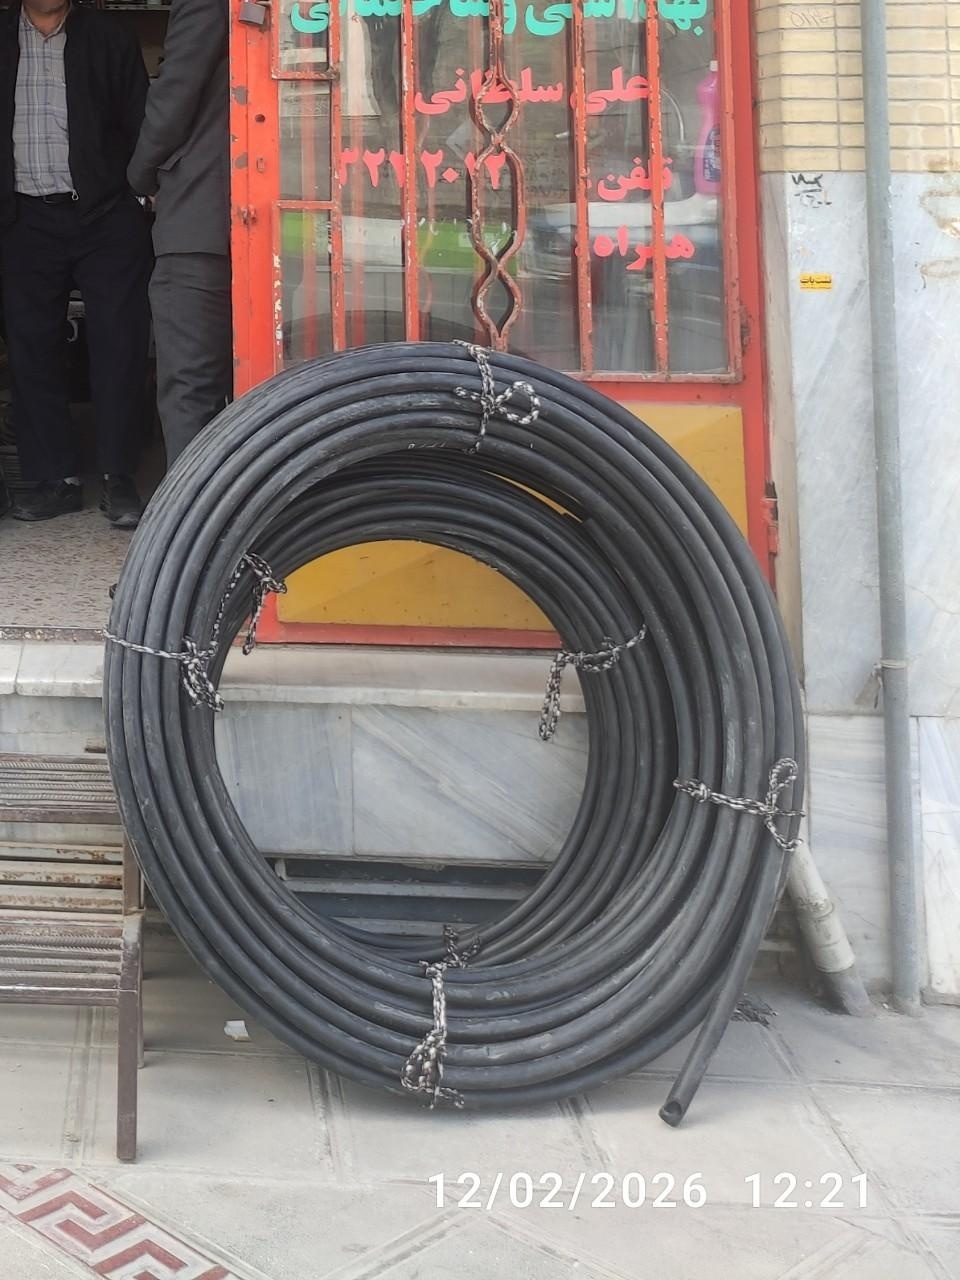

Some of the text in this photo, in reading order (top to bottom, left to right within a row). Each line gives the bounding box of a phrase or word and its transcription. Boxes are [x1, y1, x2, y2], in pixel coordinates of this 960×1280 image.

[414, 66, 648, 114] علی سلطانی
[597, 157, 672, 200] تفن
[593, 224, 695, 270] هراه
